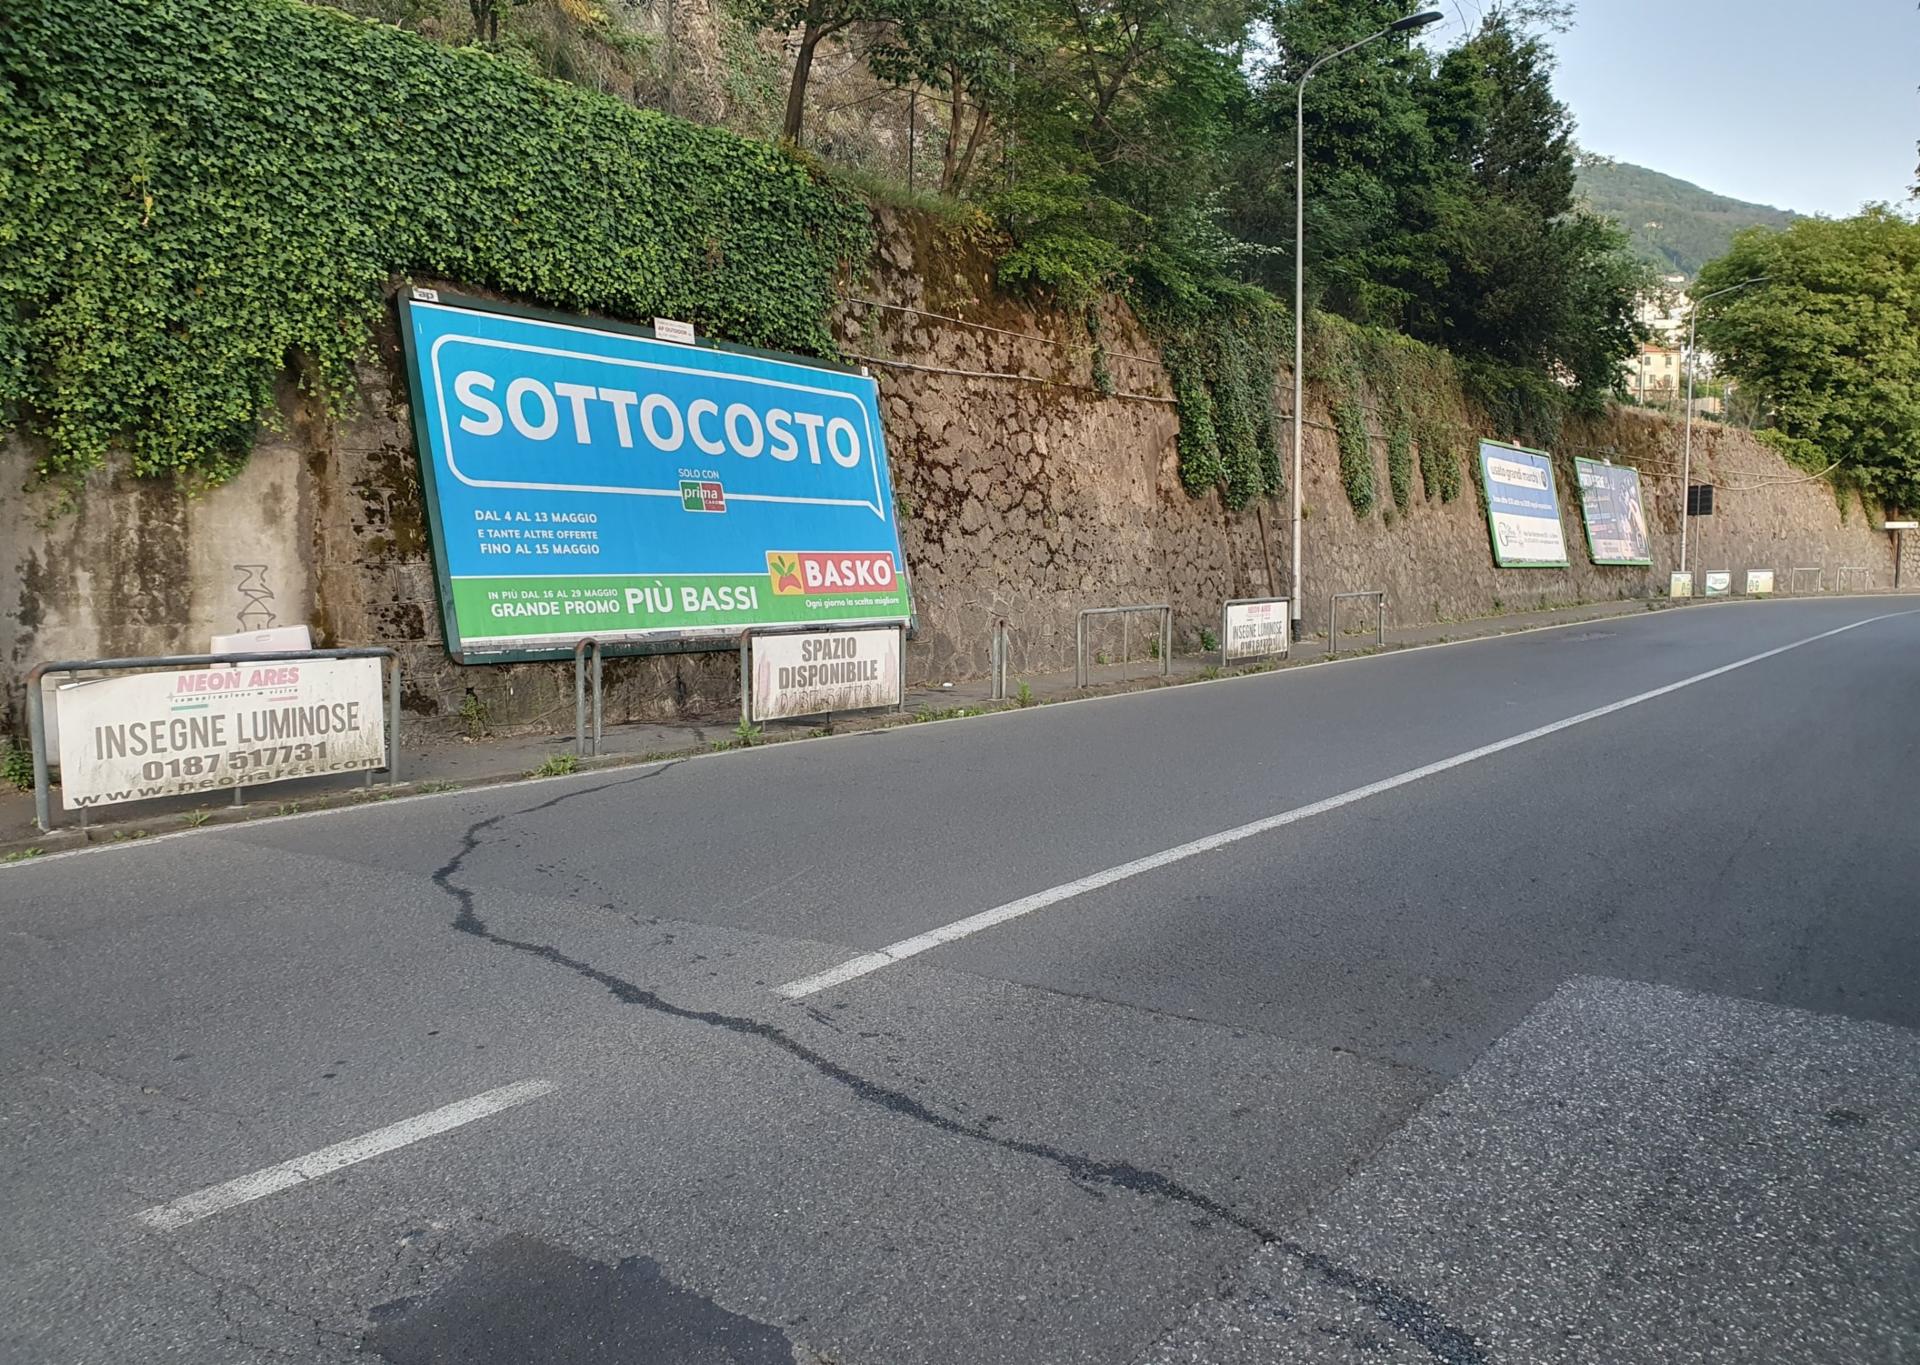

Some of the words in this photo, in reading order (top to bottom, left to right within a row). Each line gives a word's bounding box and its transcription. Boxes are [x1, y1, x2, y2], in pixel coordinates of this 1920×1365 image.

[454, 370, 861, 469] SOTTOCOSTO
[678, 468, 700, 478] SOLO
[702, 470, 720, 479] CON
[684, 486, 718, 500] prima
[474, 510, 501, 521] DAL
[504, 511, 512, 521] 4
[515, 511, 532, 522] AL
[534, 512, 548, 522] 13
[551, 513, 597, 523] MAGGIO
[477, 529, 484, 538] E
[487, 529, 521, 539] TANTE
[523, 530, 554, 539] ALTRE
[556, 530, 598, 540] OFFERTE
[480, 543, 512, 554] FINO
[515, 544, 532, 554] AL
[535, 544, 549, 554] 15
[552, 544, 600, 555] MAGGIO
[804, 559, 892, 587] BASKO
[488, 591, 498, 600] IN
[502, 589, 518, 600] PIÙ
[521, 590, 540, 599] DAL
[543, 590, 554, 599] 16
[556, 590, 569, 599] AL
[571, 589, 582, 598] 29
[584, 588, 618, 598] MAGGIO
[491, 602, 560, 618] GRANDE
[565, 600, 620, 615] PROMO
[624, 580, 673, 614] PIÙ
[681, 586, 759, 612] BASSI
[805, 599, 822, 609] Ogni
[824, 599, 846, 609] giorno
[846, 598, 854, 606] la
[854, 597, 873, 606] scelta
[874, 596, 900, 606] migliore
[802, 637, 857, 662] SPAZIO
[177, 671, 241, 693] NEON
[248, 667, 300, 688] ARES
[778, 660, 878, 690] DISPONIBILE
[95, 715, 226, 760] INSEGNE
[237, 702, 360, 743] LUMINOSE
[142, 754, 220, 781] 0187
[229, 741, 327, 770] 517731
[73, 757, 382, 807] www.neonares.com
